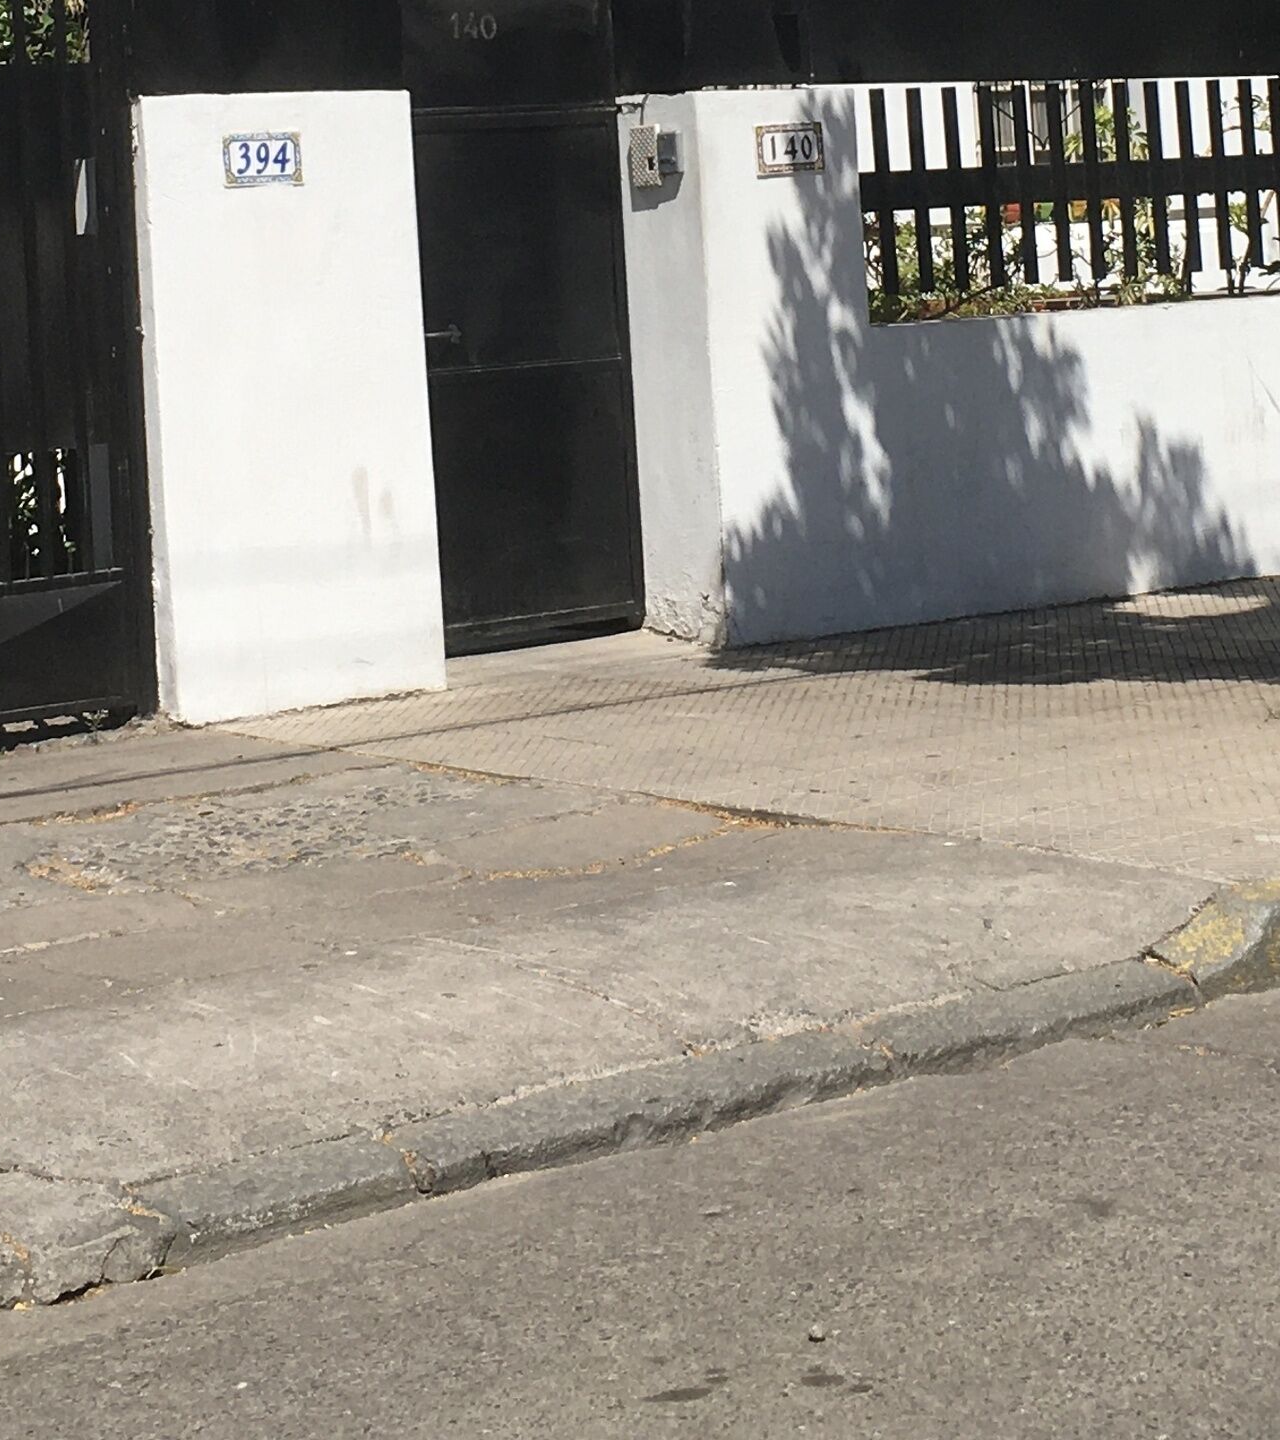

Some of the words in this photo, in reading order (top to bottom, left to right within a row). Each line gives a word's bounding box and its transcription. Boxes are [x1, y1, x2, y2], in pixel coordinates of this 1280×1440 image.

[448, 11, 498, 40] 140
[236, 141, 291, 175] 394
[769, 133, 813, 161] 140
